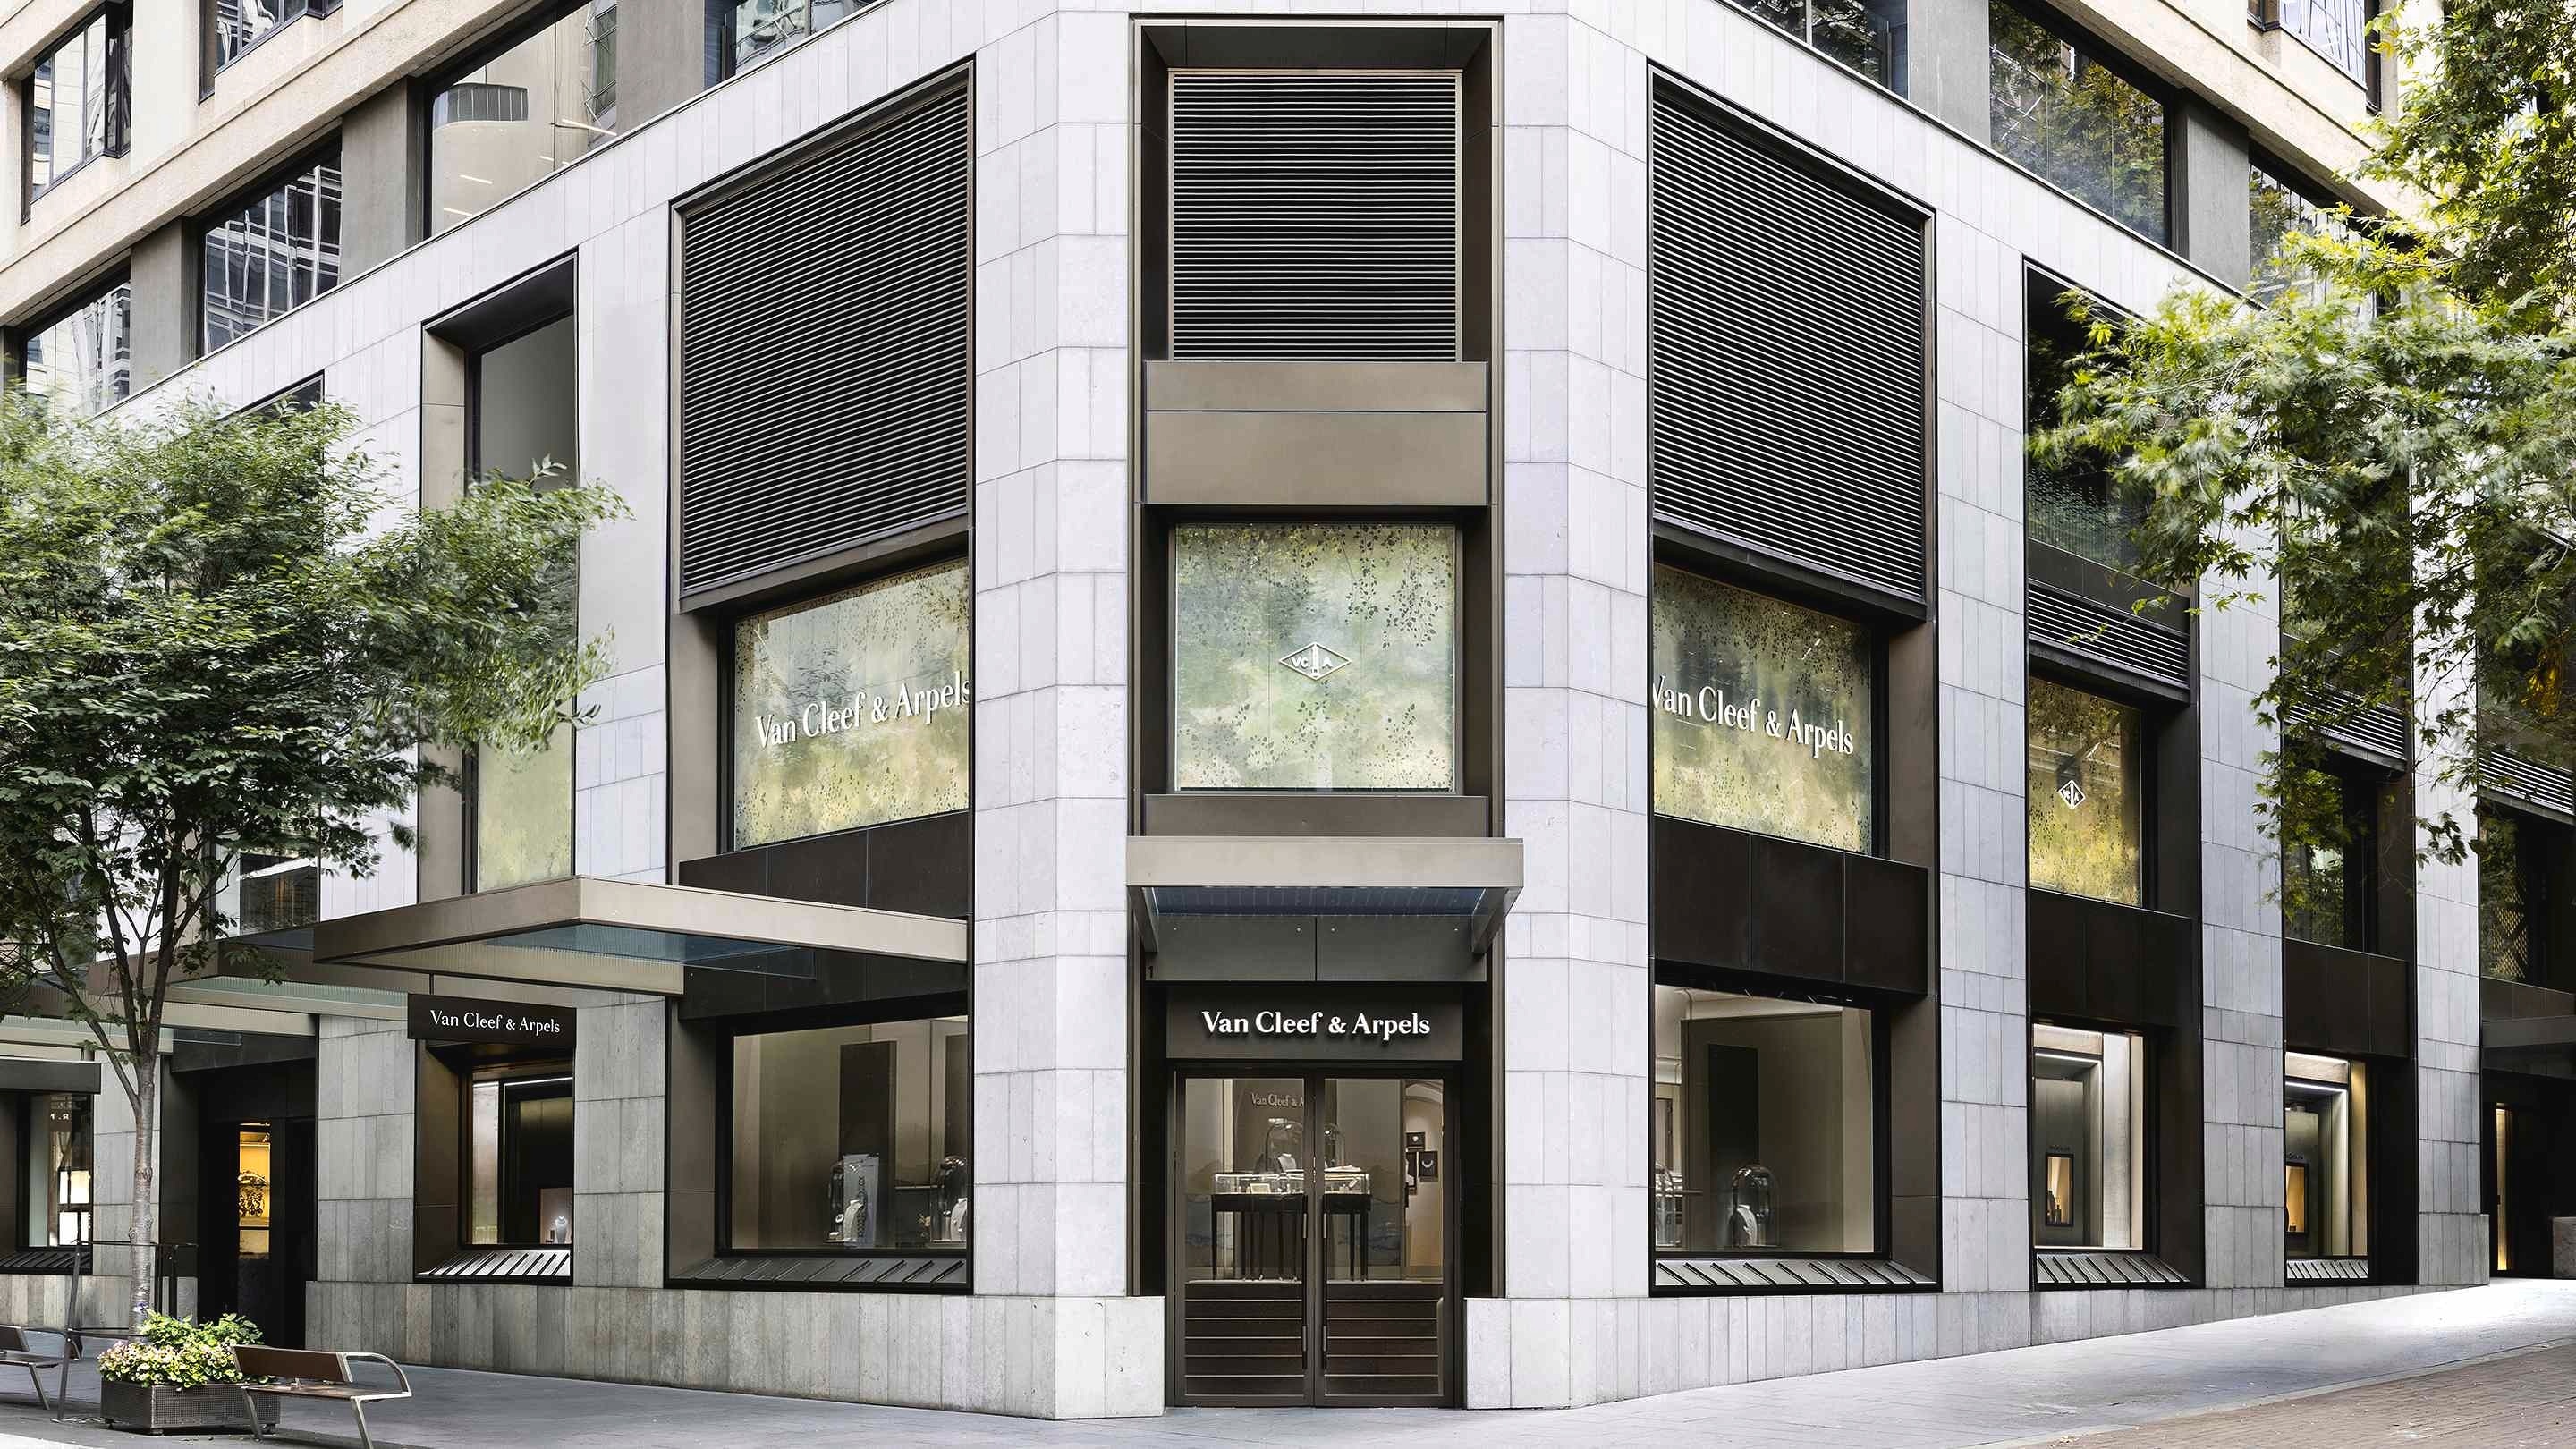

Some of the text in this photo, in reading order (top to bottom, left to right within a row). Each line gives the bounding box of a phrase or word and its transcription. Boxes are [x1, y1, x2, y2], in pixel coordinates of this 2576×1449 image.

[755, 671, 969, 749] Van Cleef & Arpels
[1653, 675, 1854, 759] Van Cleef & Arpels
[430, 1010, 560, 1037] Van Cleef & Arpels
[1202, 1011, 1431, 1041] Van Cleef & Arpels
